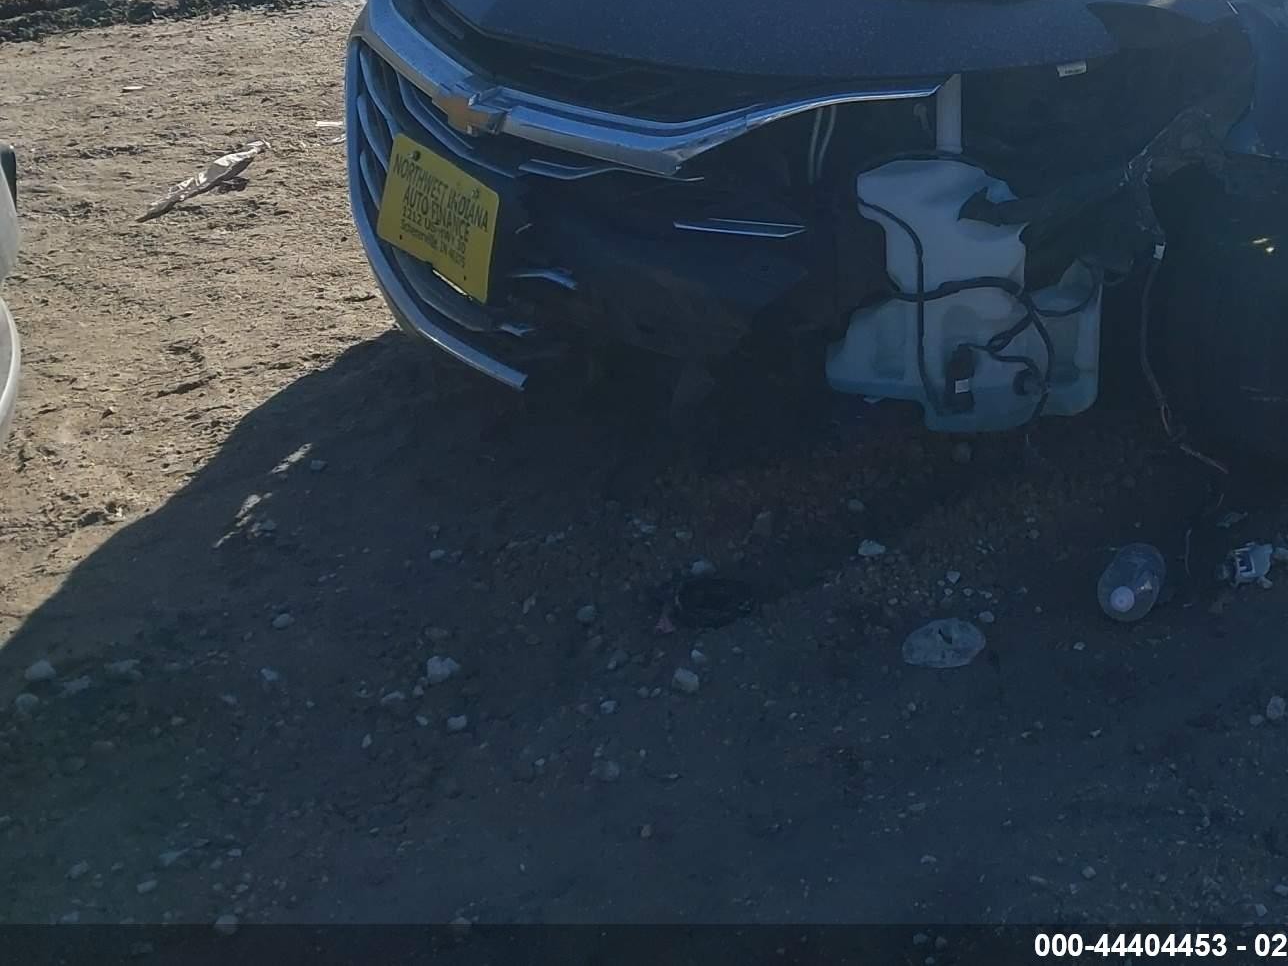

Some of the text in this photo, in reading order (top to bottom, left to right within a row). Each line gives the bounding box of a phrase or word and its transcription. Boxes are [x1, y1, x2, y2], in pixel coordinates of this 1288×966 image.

[393, 153, 488, 233] NORTHWEST INDIANA
[403, 184, 429, 215] AUTO
[431, 200, 469, 242] FINANCE
